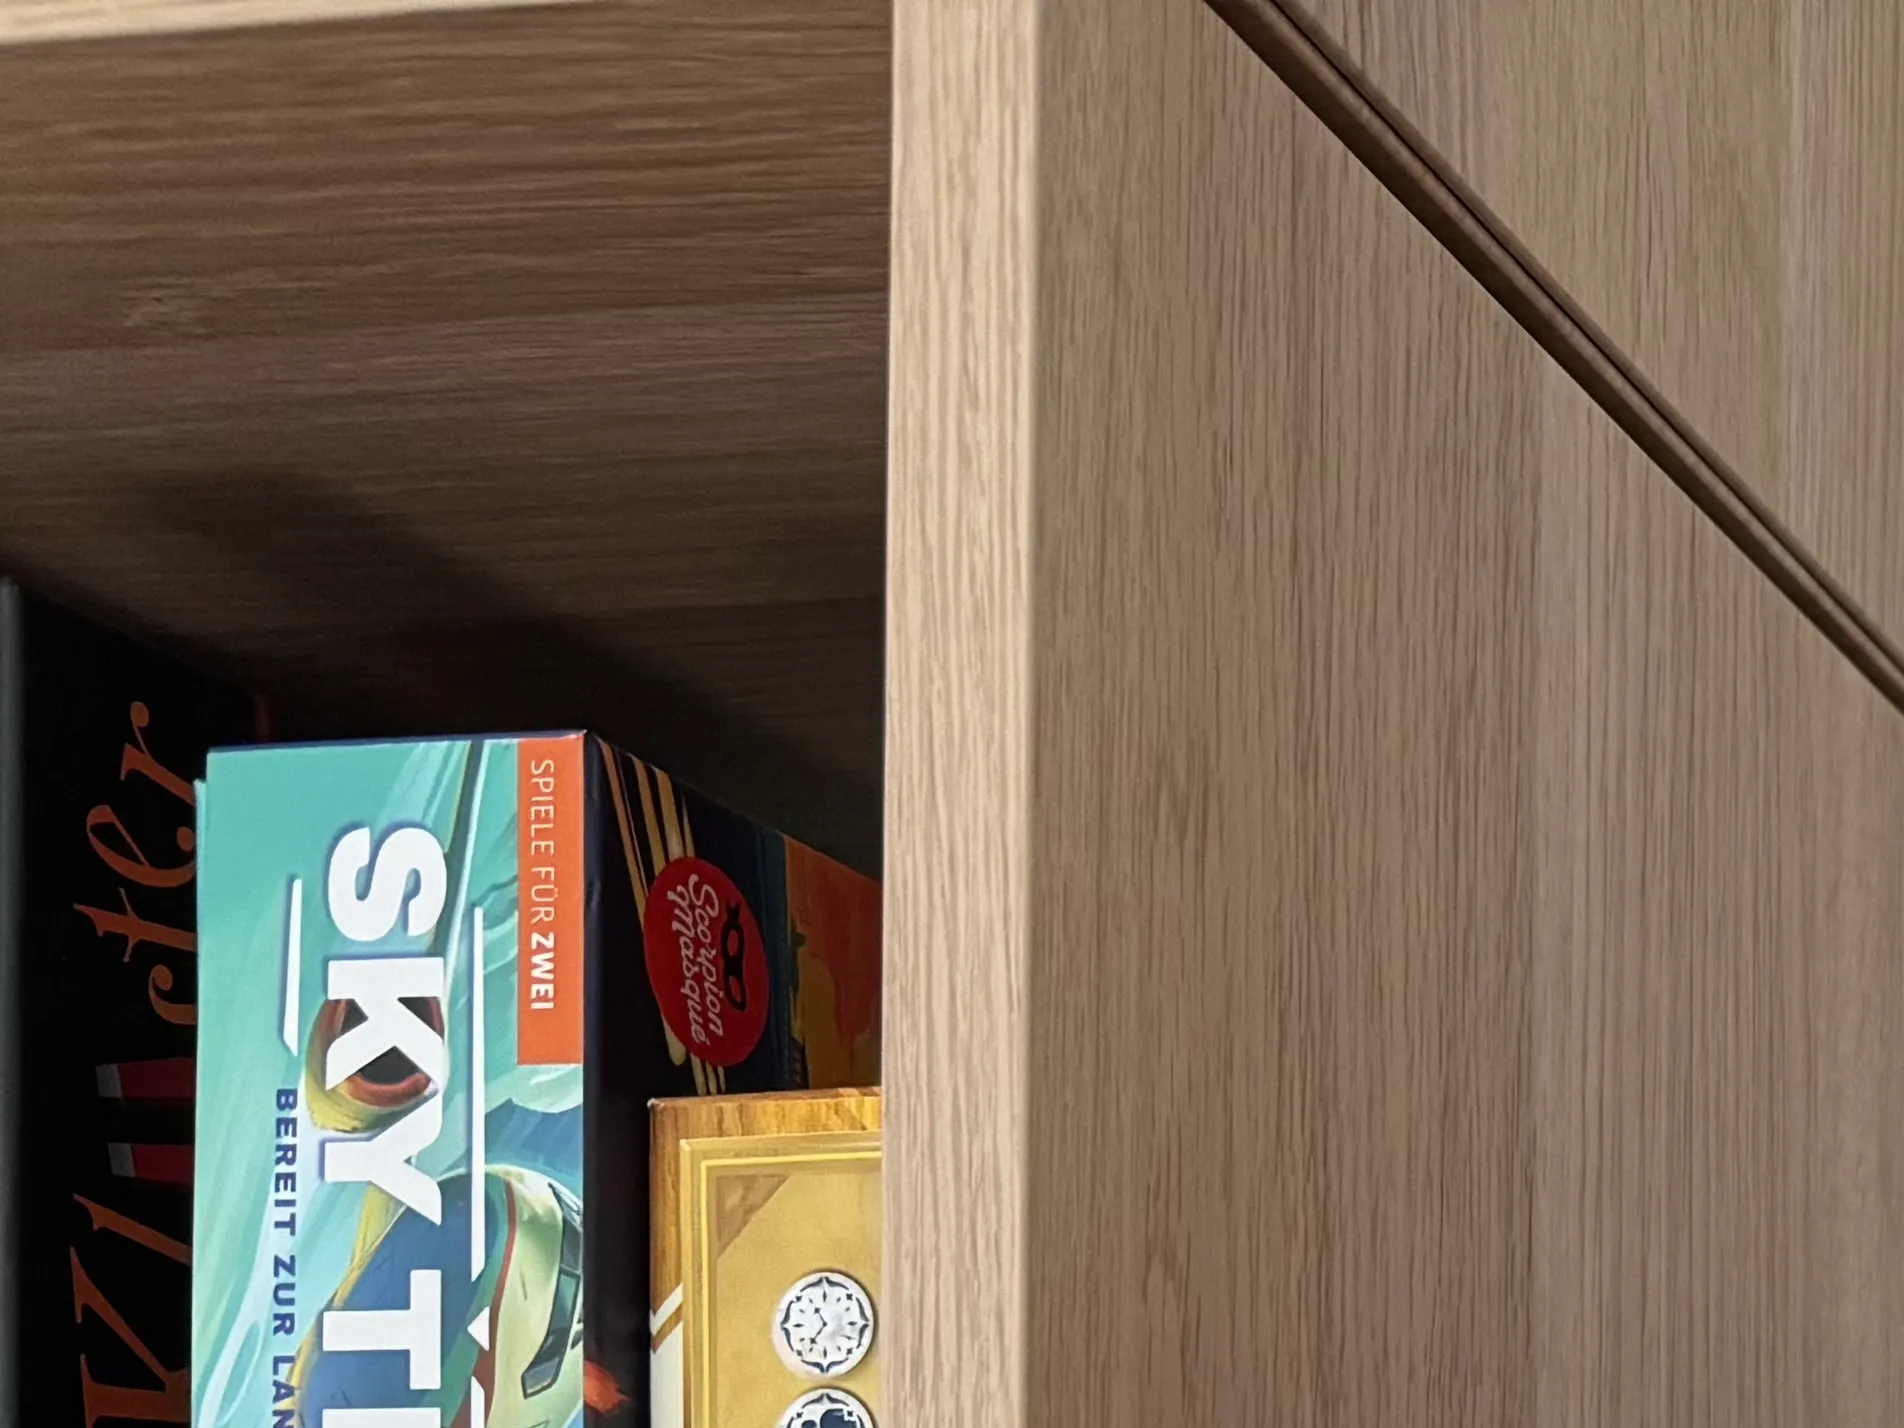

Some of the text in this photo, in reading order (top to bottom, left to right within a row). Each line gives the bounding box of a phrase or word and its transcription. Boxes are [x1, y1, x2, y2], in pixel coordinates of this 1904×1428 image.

[530, 758, 558, 1011] SPIELE FÜR ZWEI
[688, 873, 725, 1036] Scorpion
[325, 825, 448, 1227] SKY
[665, 885, 710, 1047] Masqué
[271, 1088, 299, 1239] BEREIT
[271, 1256, 298, 1337] ZUR
